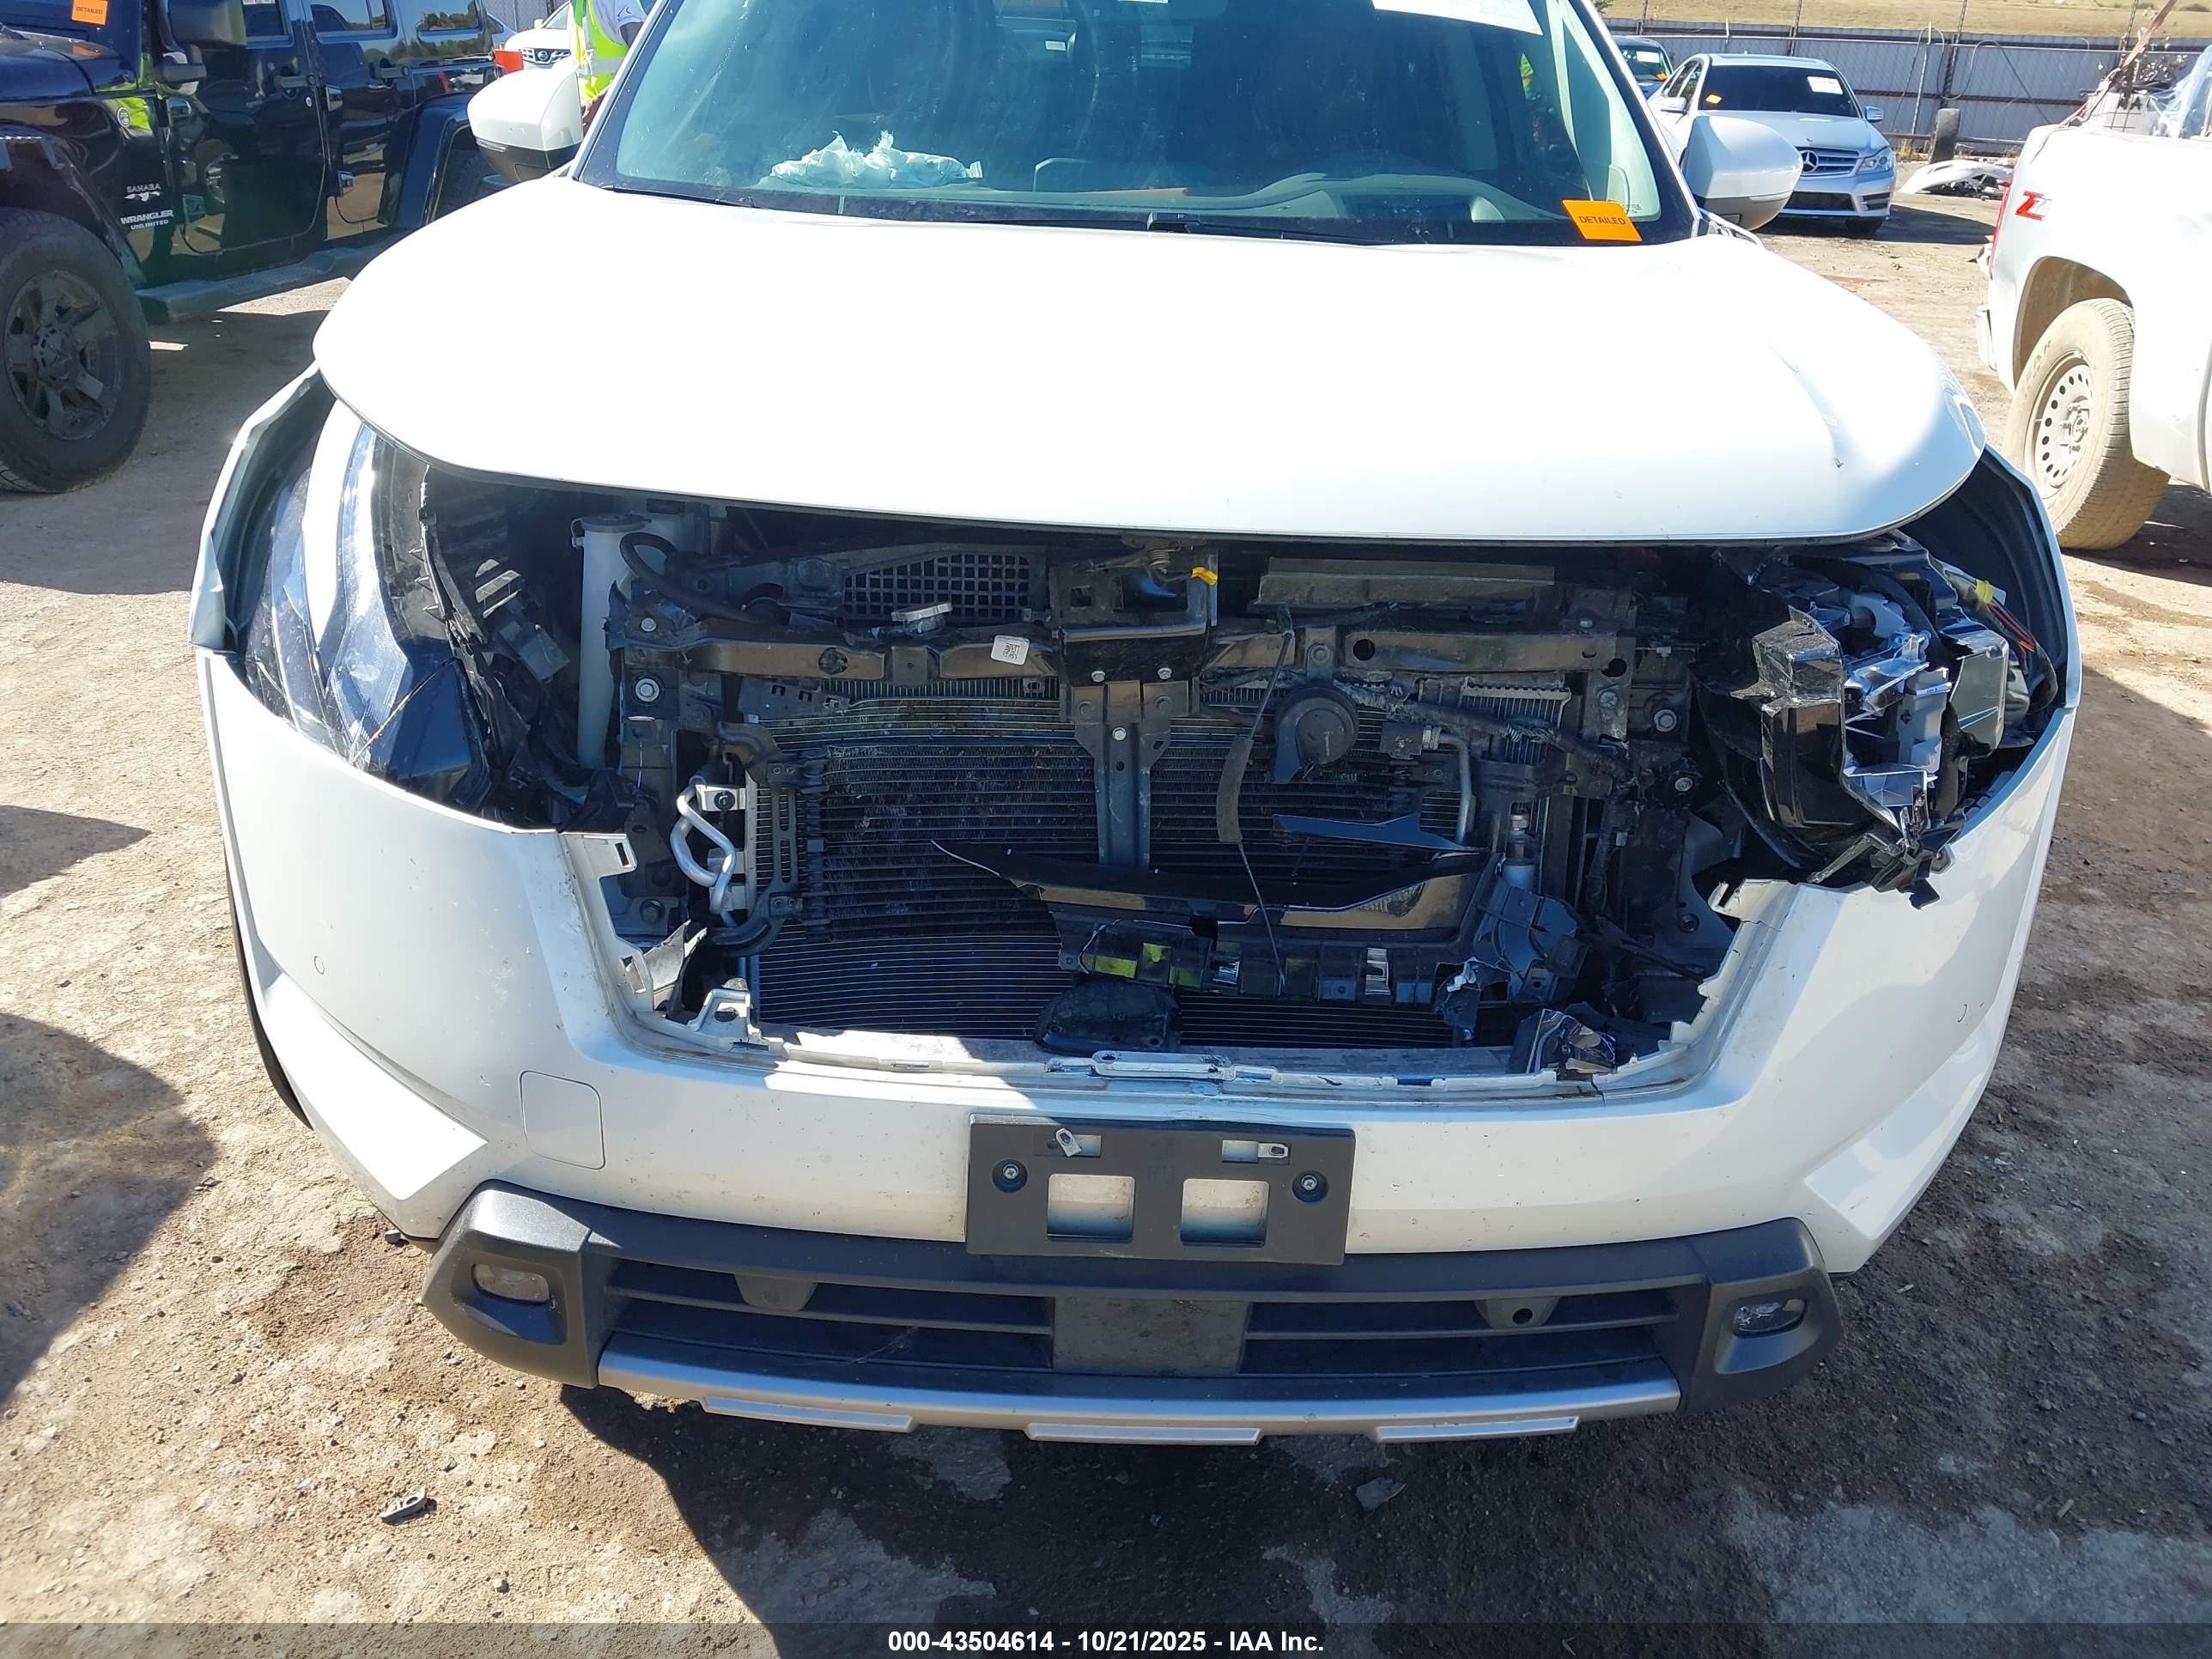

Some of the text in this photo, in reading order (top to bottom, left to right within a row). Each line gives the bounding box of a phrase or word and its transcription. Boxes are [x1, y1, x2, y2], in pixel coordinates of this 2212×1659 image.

[76, 6, 104, 15] DETAILED
[126, 183, 161, 193] SAHARA
[120, 210, 174, 224] WRANGLER
[1578, 216, 1626, 225] DETAILED
[131, 219, 169, 230] UNLIMITED
